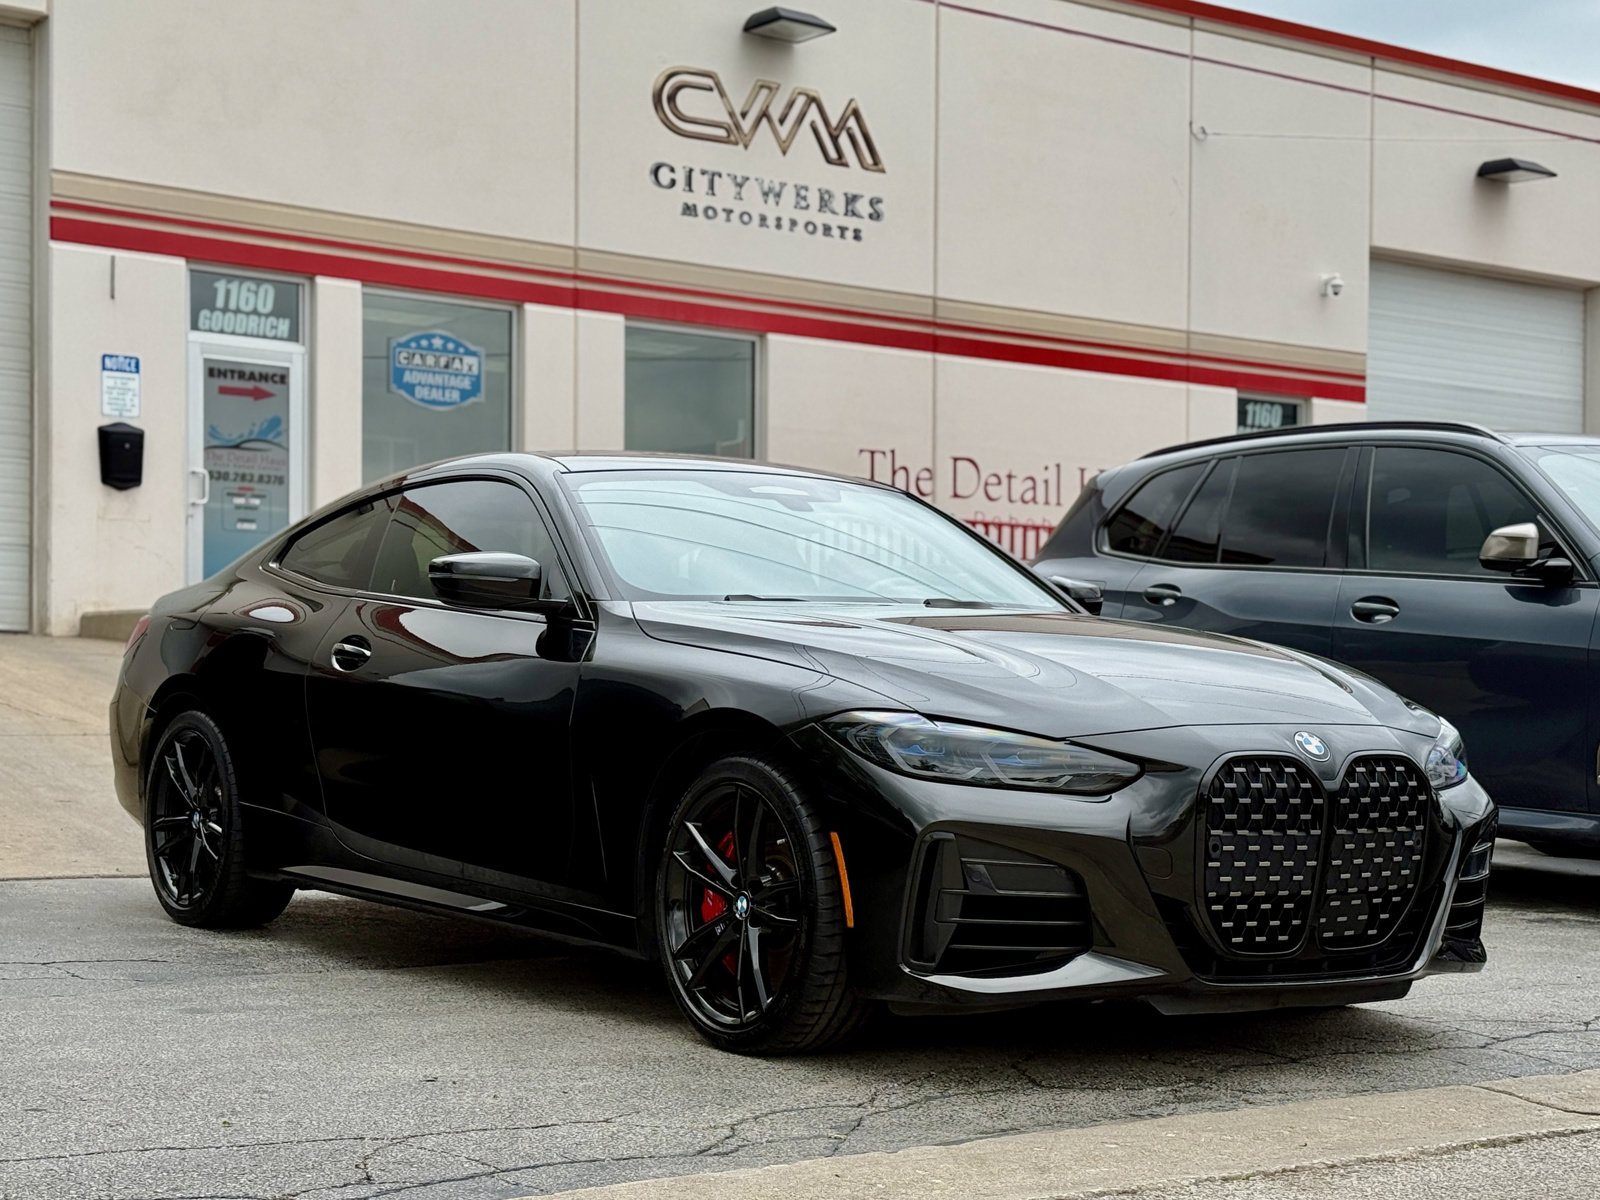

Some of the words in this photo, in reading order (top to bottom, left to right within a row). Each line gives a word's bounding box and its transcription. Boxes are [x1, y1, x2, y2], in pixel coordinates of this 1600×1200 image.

[650, 161, 884, 221] CITYWERKS
[680, 202, 863, 242] MOTORSPORTS
[213, 279, 275, 314] 1160
[198, 308, 290, 339] GOODRICH
[207, 366, 287, 385] ENTRANCE
[398, 351, 479, 376] CARFAX
[403, 369, 473, 390] ADVANTAGE
[414, 385, 460, 402] DEALER
[1245, 402, 1283, 429] 1160
[858, 449, 933, 497] The
[951, 456, 1063, 506] Detail
